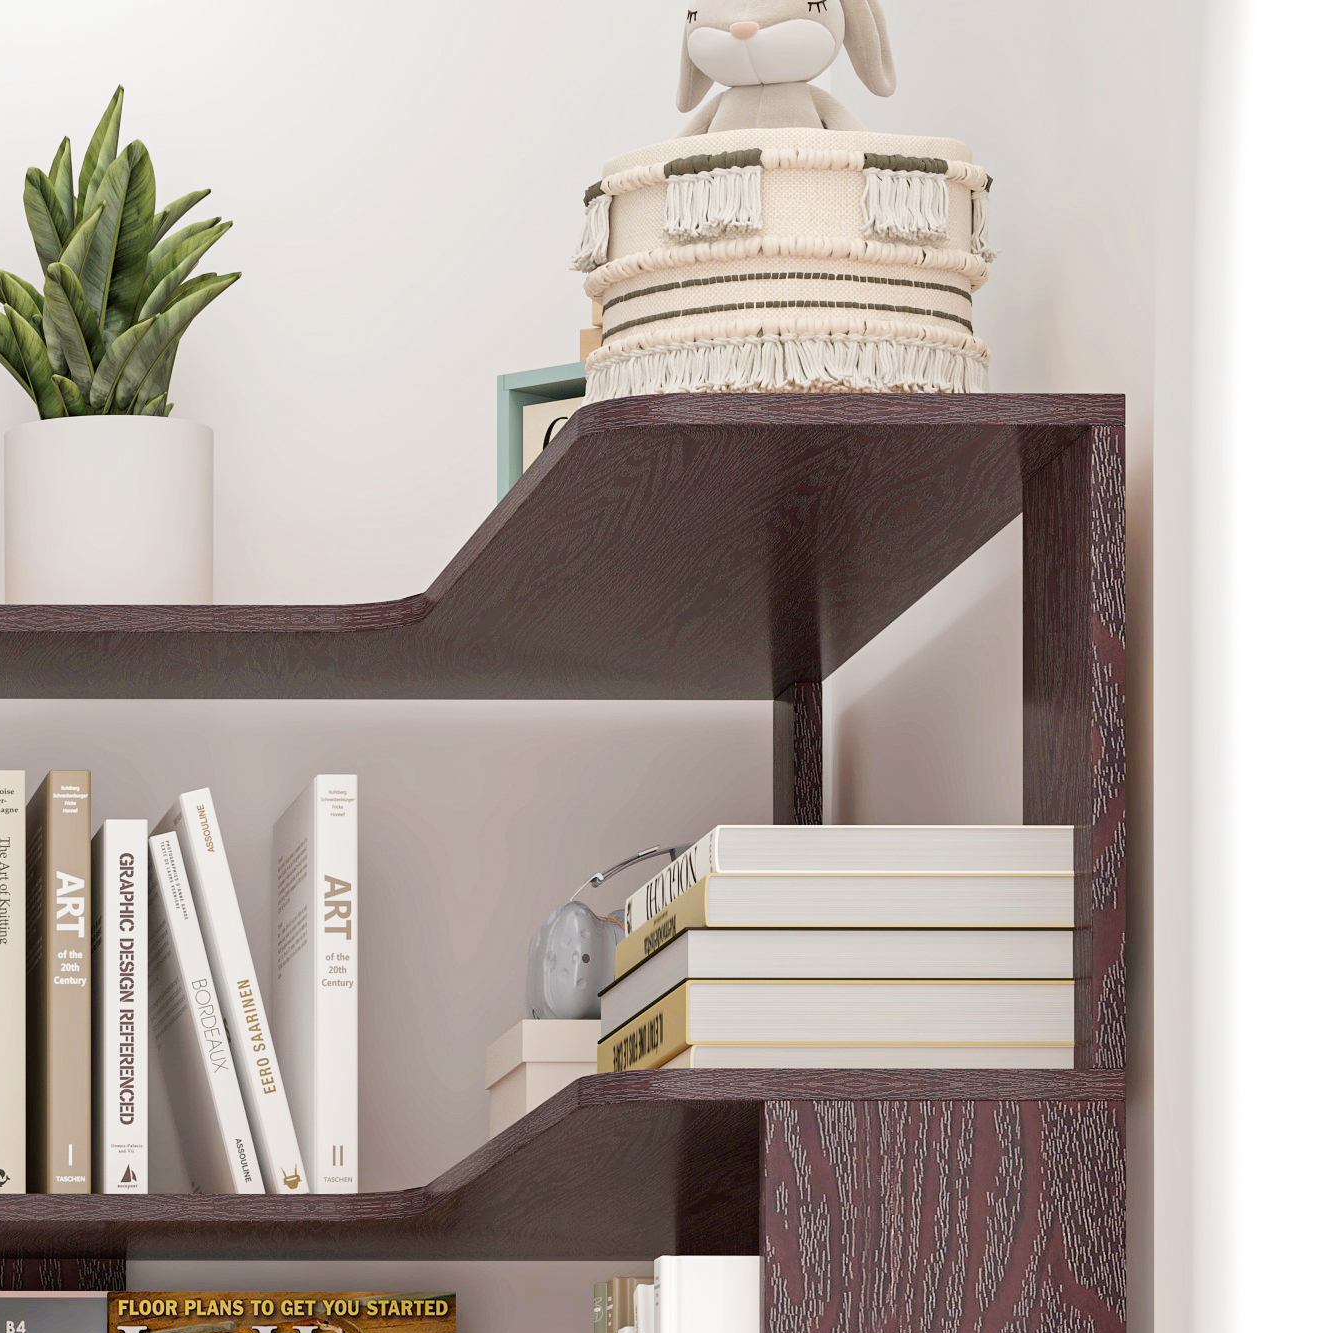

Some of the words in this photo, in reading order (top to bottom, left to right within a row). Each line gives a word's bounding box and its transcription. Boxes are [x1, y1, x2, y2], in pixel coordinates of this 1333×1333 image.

[119, 852, 135, 932] GRAPHIC
[119, 938, 135, 1003] DESIGN
[119, 1009, 135, 1126] REFERENCED
